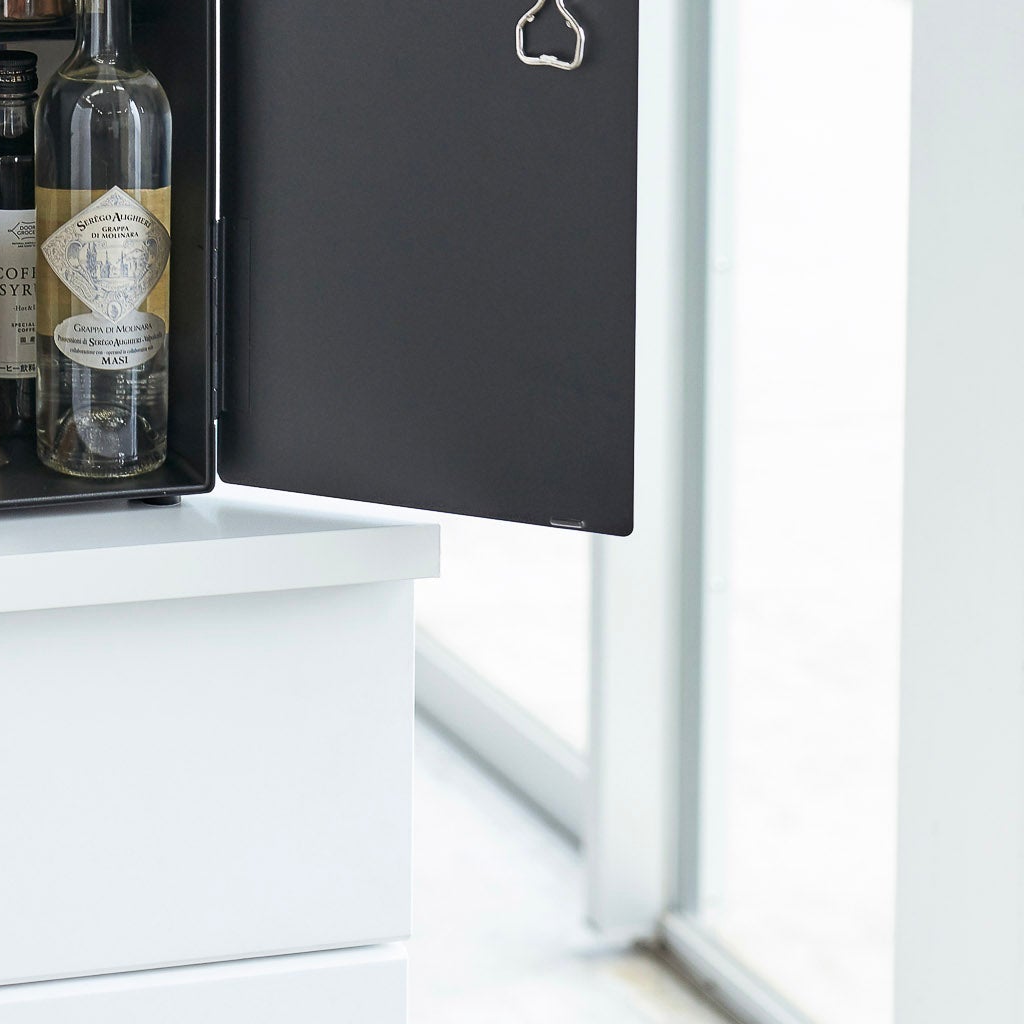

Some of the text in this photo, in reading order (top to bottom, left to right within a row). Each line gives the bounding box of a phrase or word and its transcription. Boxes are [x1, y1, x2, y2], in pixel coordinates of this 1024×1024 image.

[101, 225, 129, 233] GRAPPA
[101, 231, 139, 239] MOLINARA
[73, 322, 153, 334] GRAPPA DI MOLINARA
[101, 356, 129, 366] MASI
